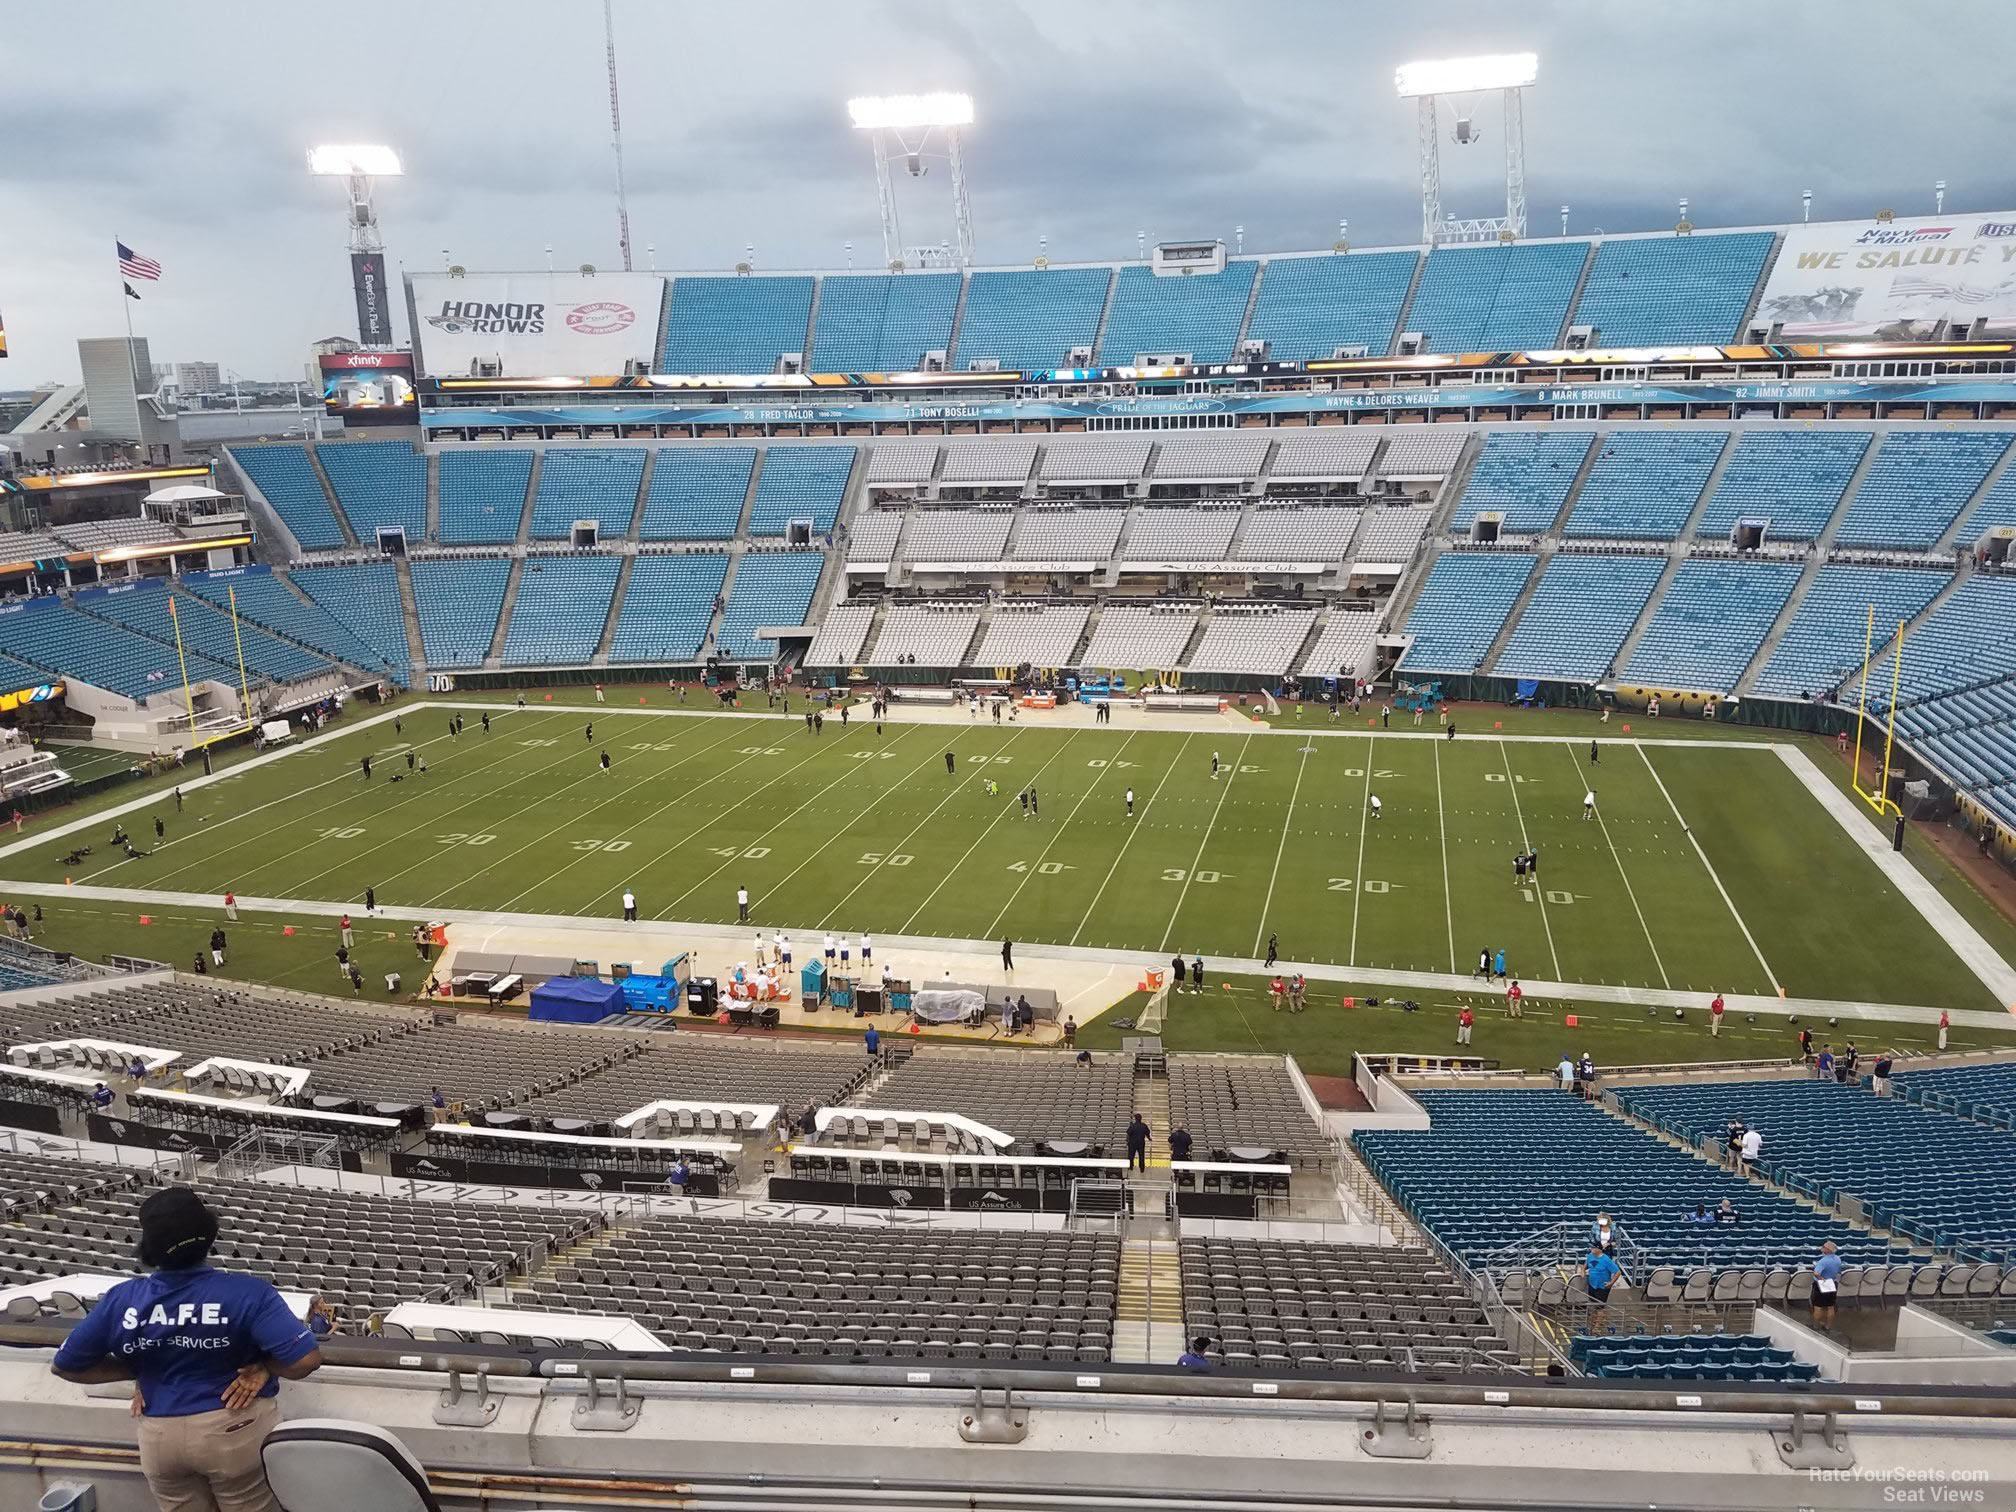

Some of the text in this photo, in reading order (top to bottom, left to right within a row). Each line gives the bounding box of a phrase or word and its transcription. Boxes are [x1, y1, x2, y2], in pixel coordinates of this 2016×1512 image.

[1863, 228, 1915, 239] Navy
[1874, 232, 1951, 246] Mutual
[1796, 251, 1848, 270] WE
[1855, 244, 1986, 270] SALUTE
[364, 274, 380, 335] EverBank Field
[441, 300, 545, 320] HONOR
[471, 319, 545, 334] ROWS
[347, 355, 383, 367] xfinity
[1538, 391, 1545, 401] 8
[1552, 390, 1578, 401] MARK
[1581, 389, 1623, 400] BRUNELL
[1736, 387, 1747, 398] 82
[1754, 387, 1785, 398] JIMMY
[1787, 386, 1816, 397] SMITH
[1325, 396, 1355, 407] WAYNE
[1365, 395, 1403, 406] DELORES
[1404, 393, 1440, 404] WEAVER
[905, 408, 915, 418] 71
[920, 407, 942, 418] TONY
[944, 406, 980, 417] BOSELLI
[1112, 402, 1140, 413] PRIDE
[1168, 401, 1209, 412] JAGUARS
[744, 410, 755, 420] 28
[760, 410, 782, 420] FRED
[783, 410, 814, 420] TAYLOR
[225, 569, 245, 577] LIGHT
[965, 563, 1071, 571] US Assure Club
[1186, 563, 1298, 572] US Assure Club
[121, 584, 135, 593] LIGHT
[6, 604, 24, 614] LIGHT
[323, 826, 367, 840] 10
[440, 833, 498, 846] 20
[572, 839, 633, 852] 30
[715, 845, 773, 859] 40
[856, 852, 916, 867] 50
[1006, 860, 1066, 874] 40
[1160, 868, 1221, 883] 30
[1327, 877, 1391, 893] 20
[1518, 888, 1575, 904] 10
[1584, 1064, 1595, 1074] 34
[405, 1166, 452, 1178] US Assure Club
[651, 1185, 660, 1193] US
[685, 1186, 702, 1194] Club
[968, 1201, 1022, 1210] US Assure Club
[122, 1302, 229, 1330] S.A.F.E.
[166, 1335, 231, 1350] SERVICES
